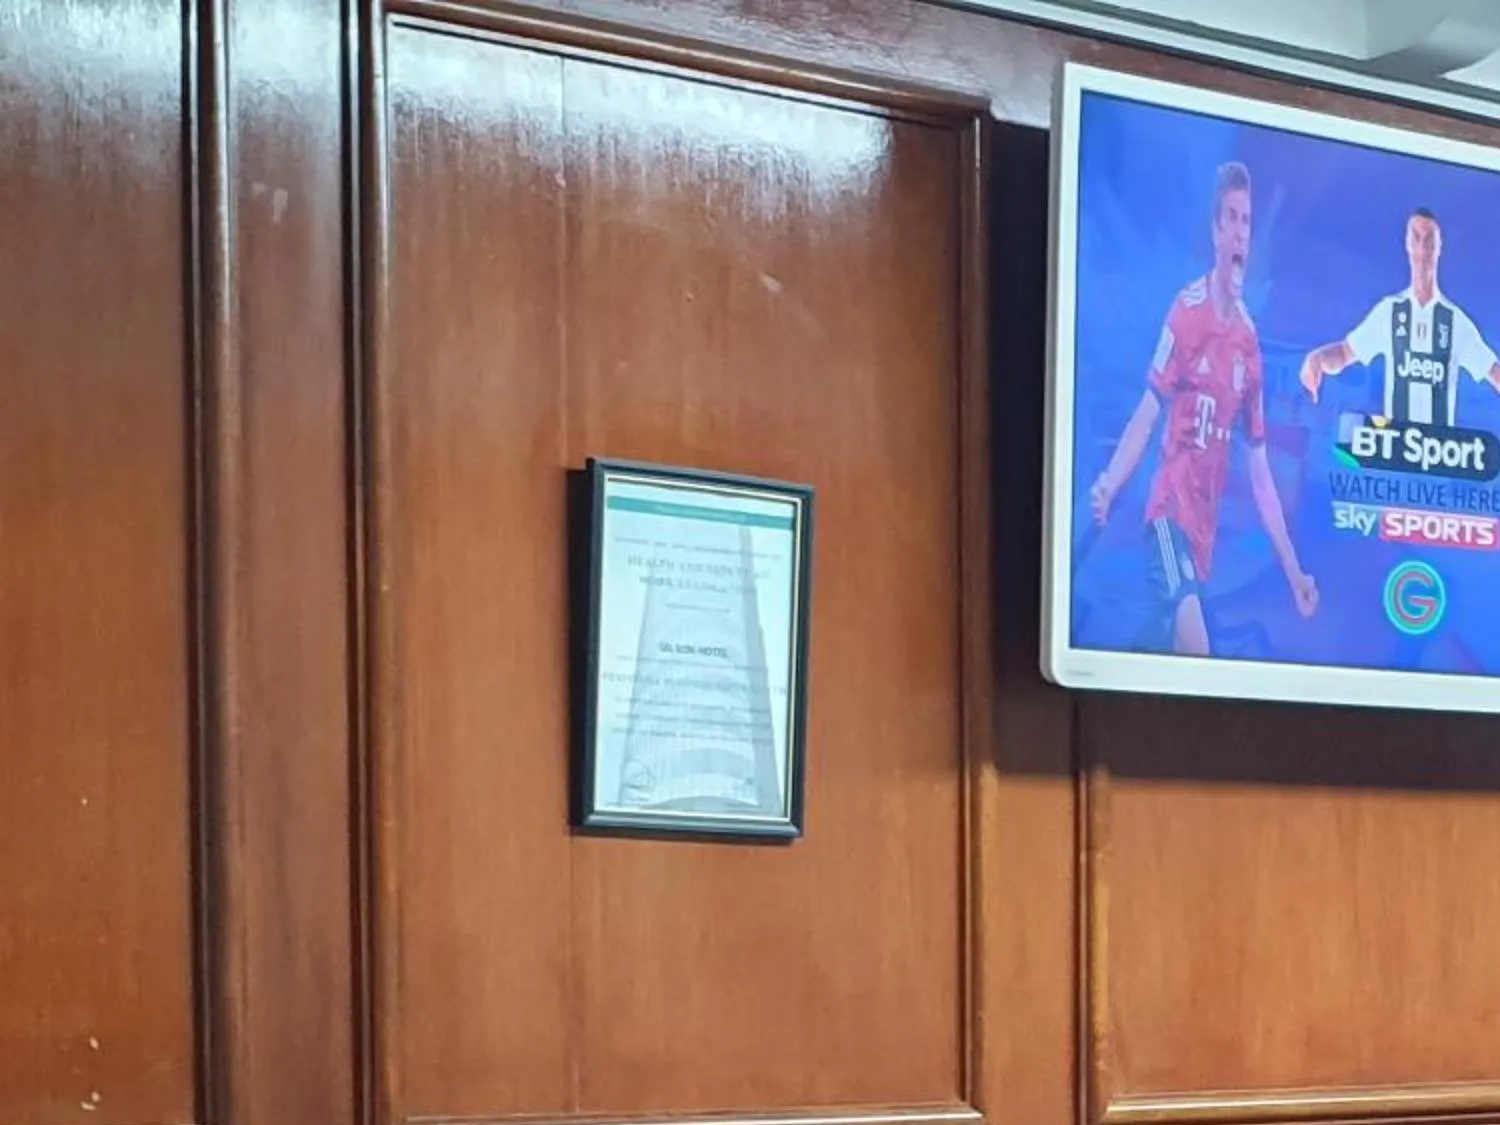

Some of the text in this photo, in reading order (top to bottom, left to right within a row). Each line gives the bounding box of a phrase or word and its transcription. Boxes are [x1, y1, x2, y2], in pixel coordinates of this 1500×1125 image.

[1398, 352, 1444, 384] Jeep
[1351, 426, 1485, 471] BT Sport
[1329, 471, 1500, 513] WATCH LIVE HERE
[1334, 504, 1494, 545] sky SPORTS
